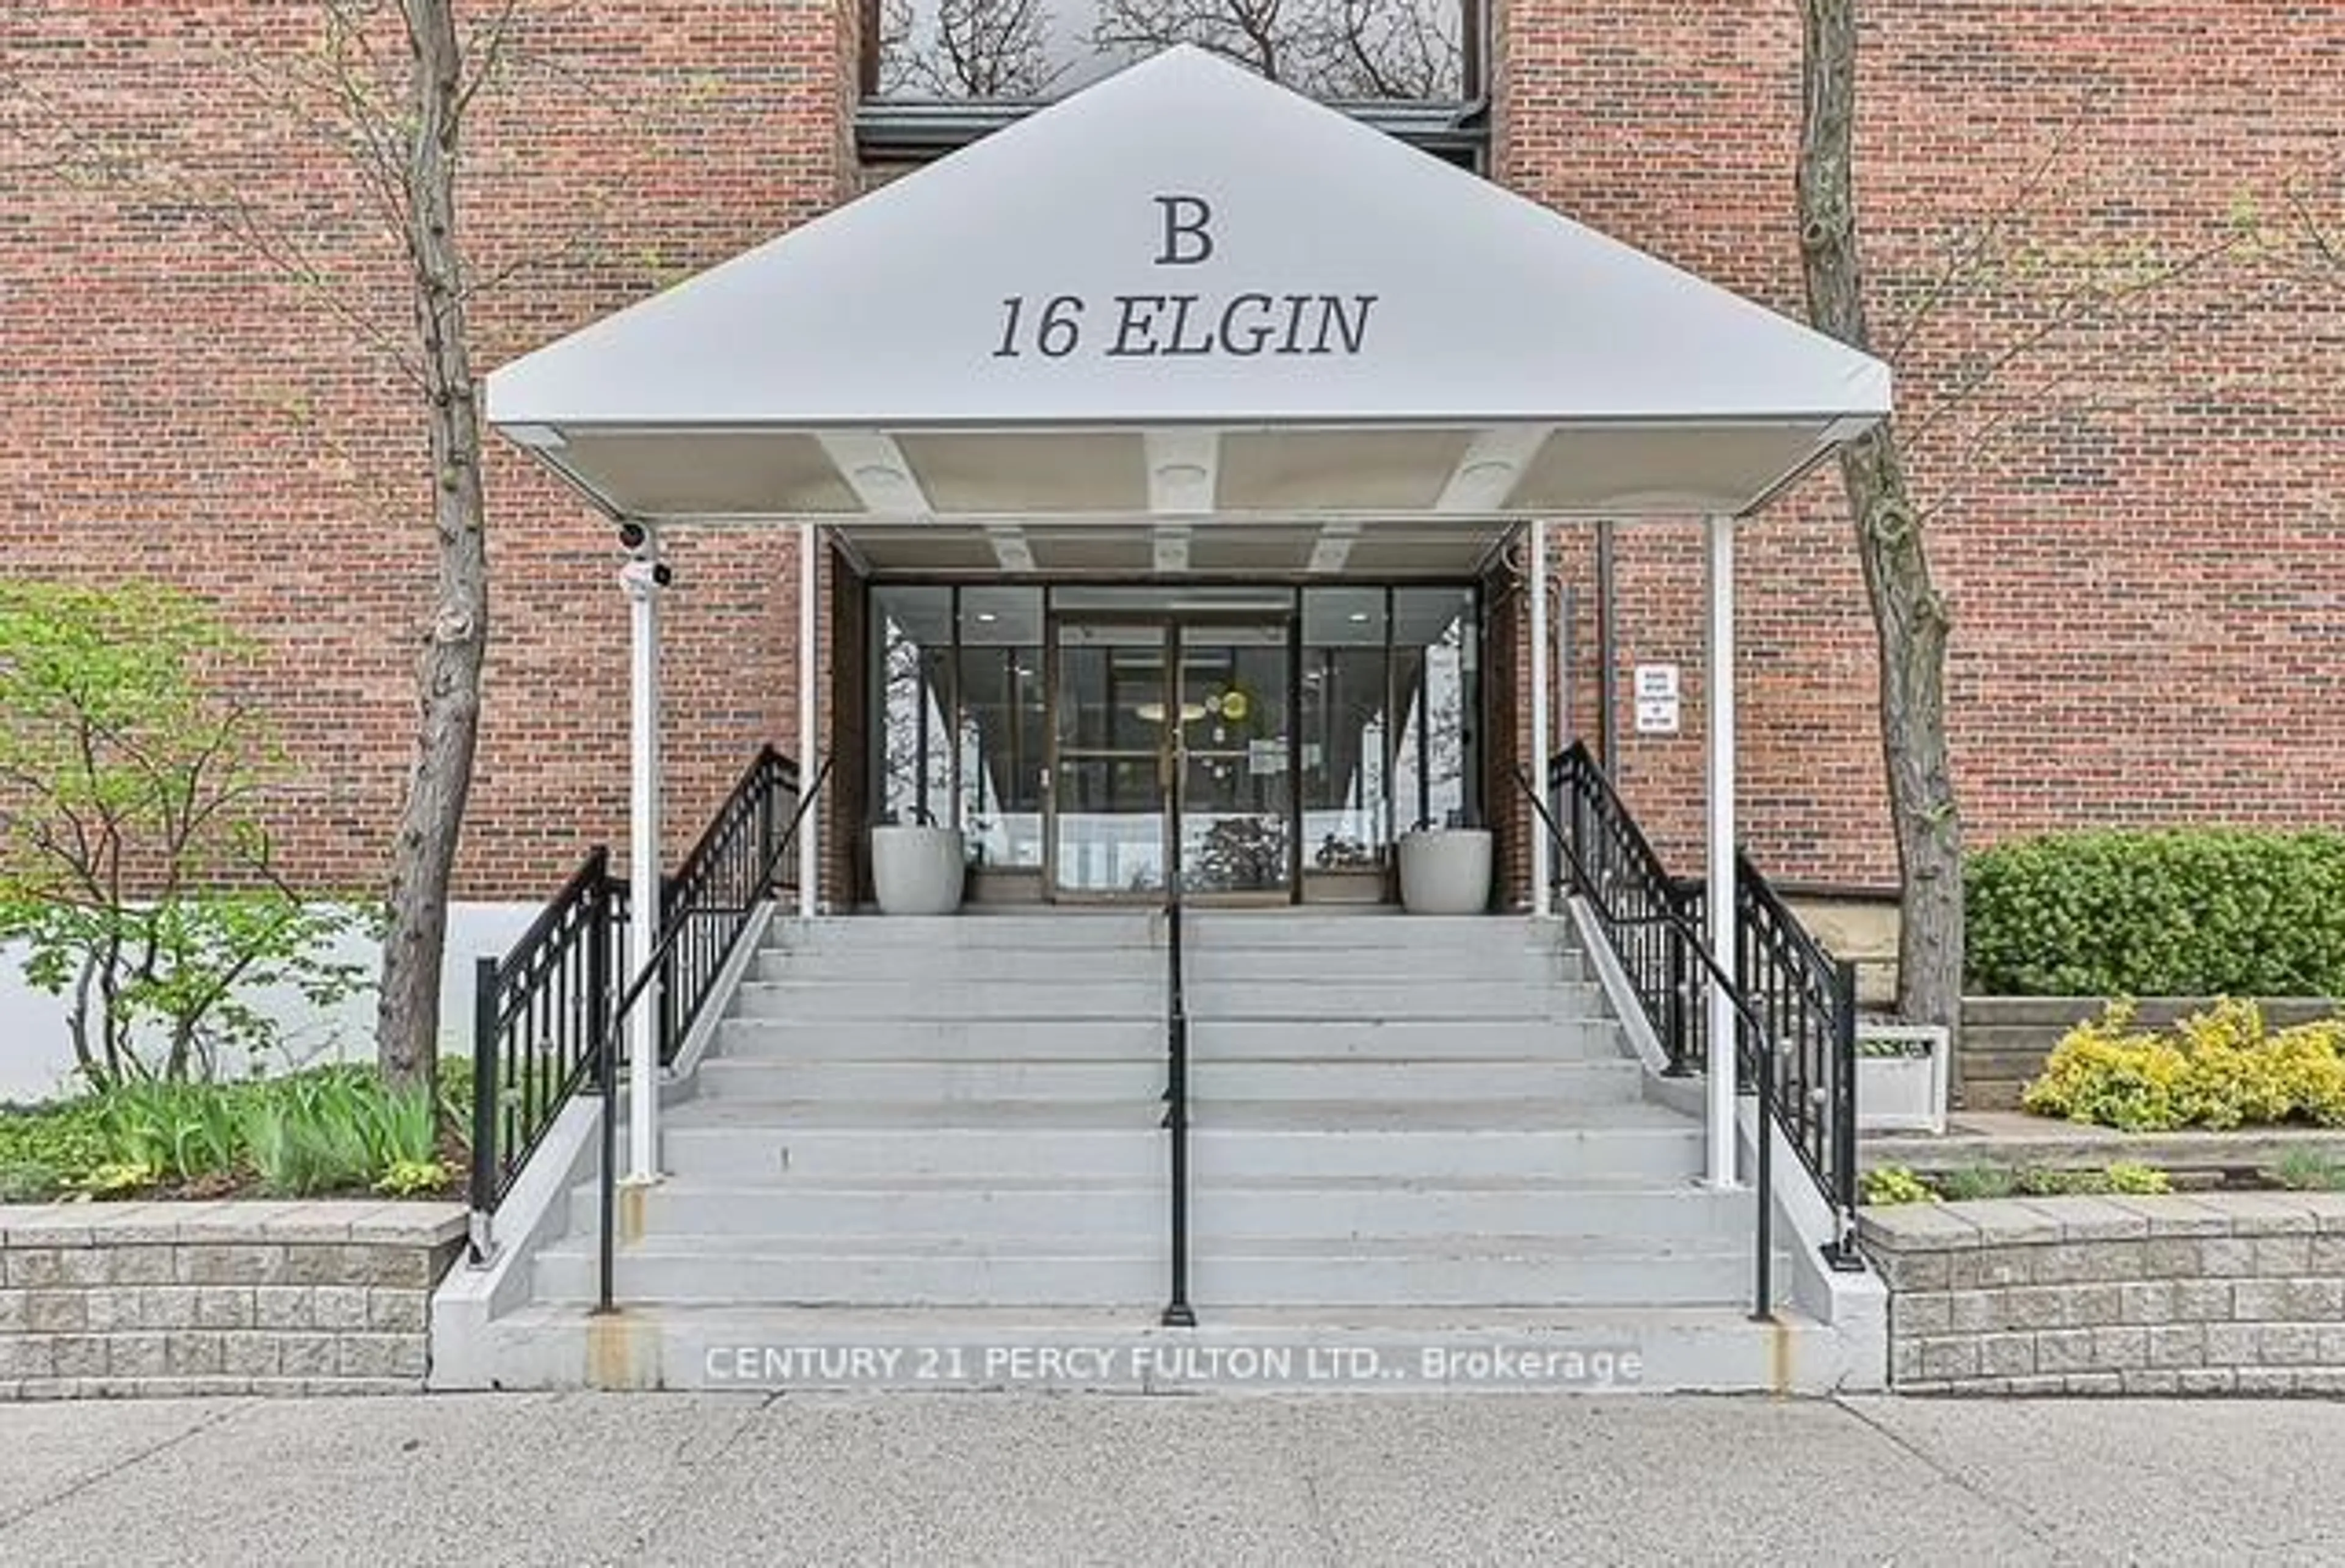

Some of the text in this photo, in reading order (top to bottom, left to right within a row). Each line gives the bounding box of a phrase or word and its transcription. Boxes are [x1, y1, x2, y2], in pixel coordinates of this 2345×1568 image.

[1154, 196, 1213, 265] B
[992, 293, 1379, 357] 16 ELGIN
